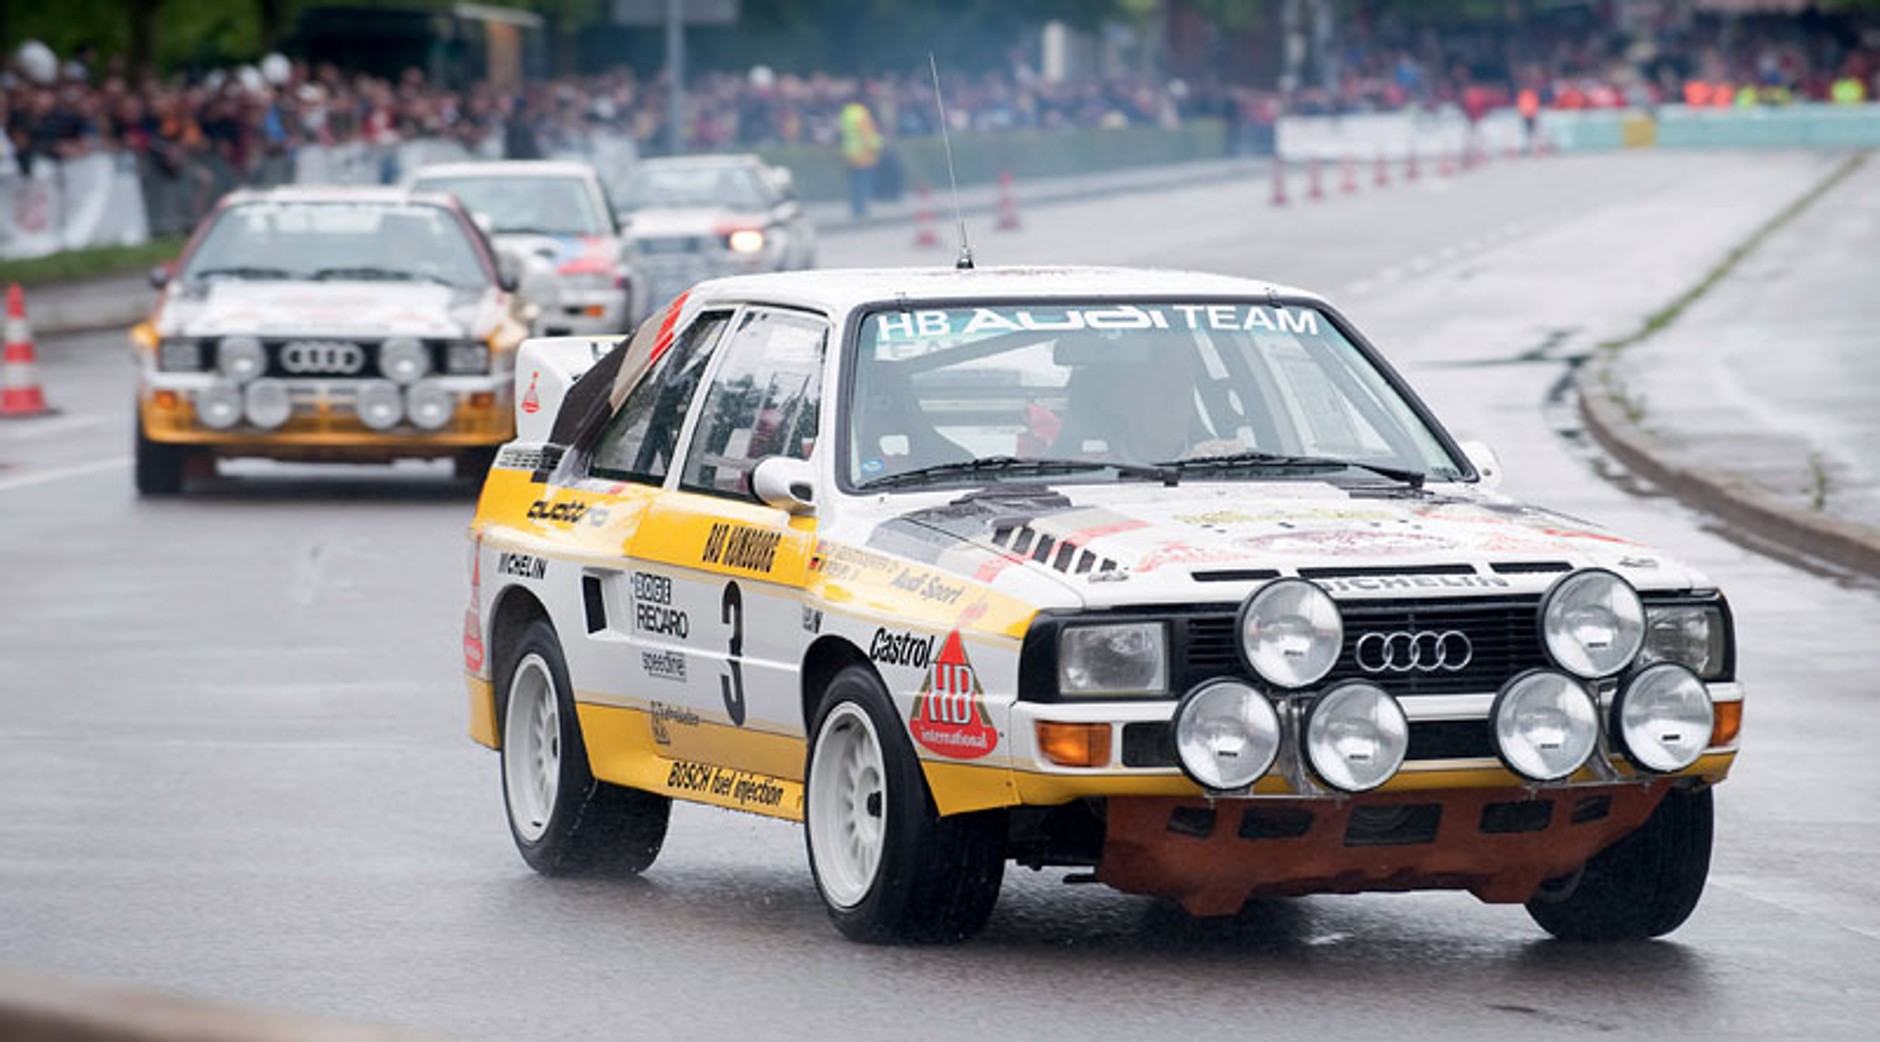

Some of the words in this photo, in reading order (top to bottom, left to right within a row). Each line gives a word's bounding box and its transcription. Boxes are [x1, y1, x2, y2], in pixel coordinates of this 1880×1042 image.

[877, 309, 950, 342] HB
[1172, 304, 1318, 336] TEAM
[702, 521, 730, 563] BAD
[499, 553, 547, 580] MICHELIN
[634, 571, 671, 605] BOGE
[920, 575, 966, 604] Sport
[636, 602, 689, 639] RECARO
[720, 579, 745, 727] 3
[869, 626, 935, 669] Castrol
[928, 662, 974, 724] HB
[920, 726, 988, 749] international
[667, 761, 713, 792] BOSCH
[709, 768, 737, 797] fuel
[732, 773, 785, 806] injection
